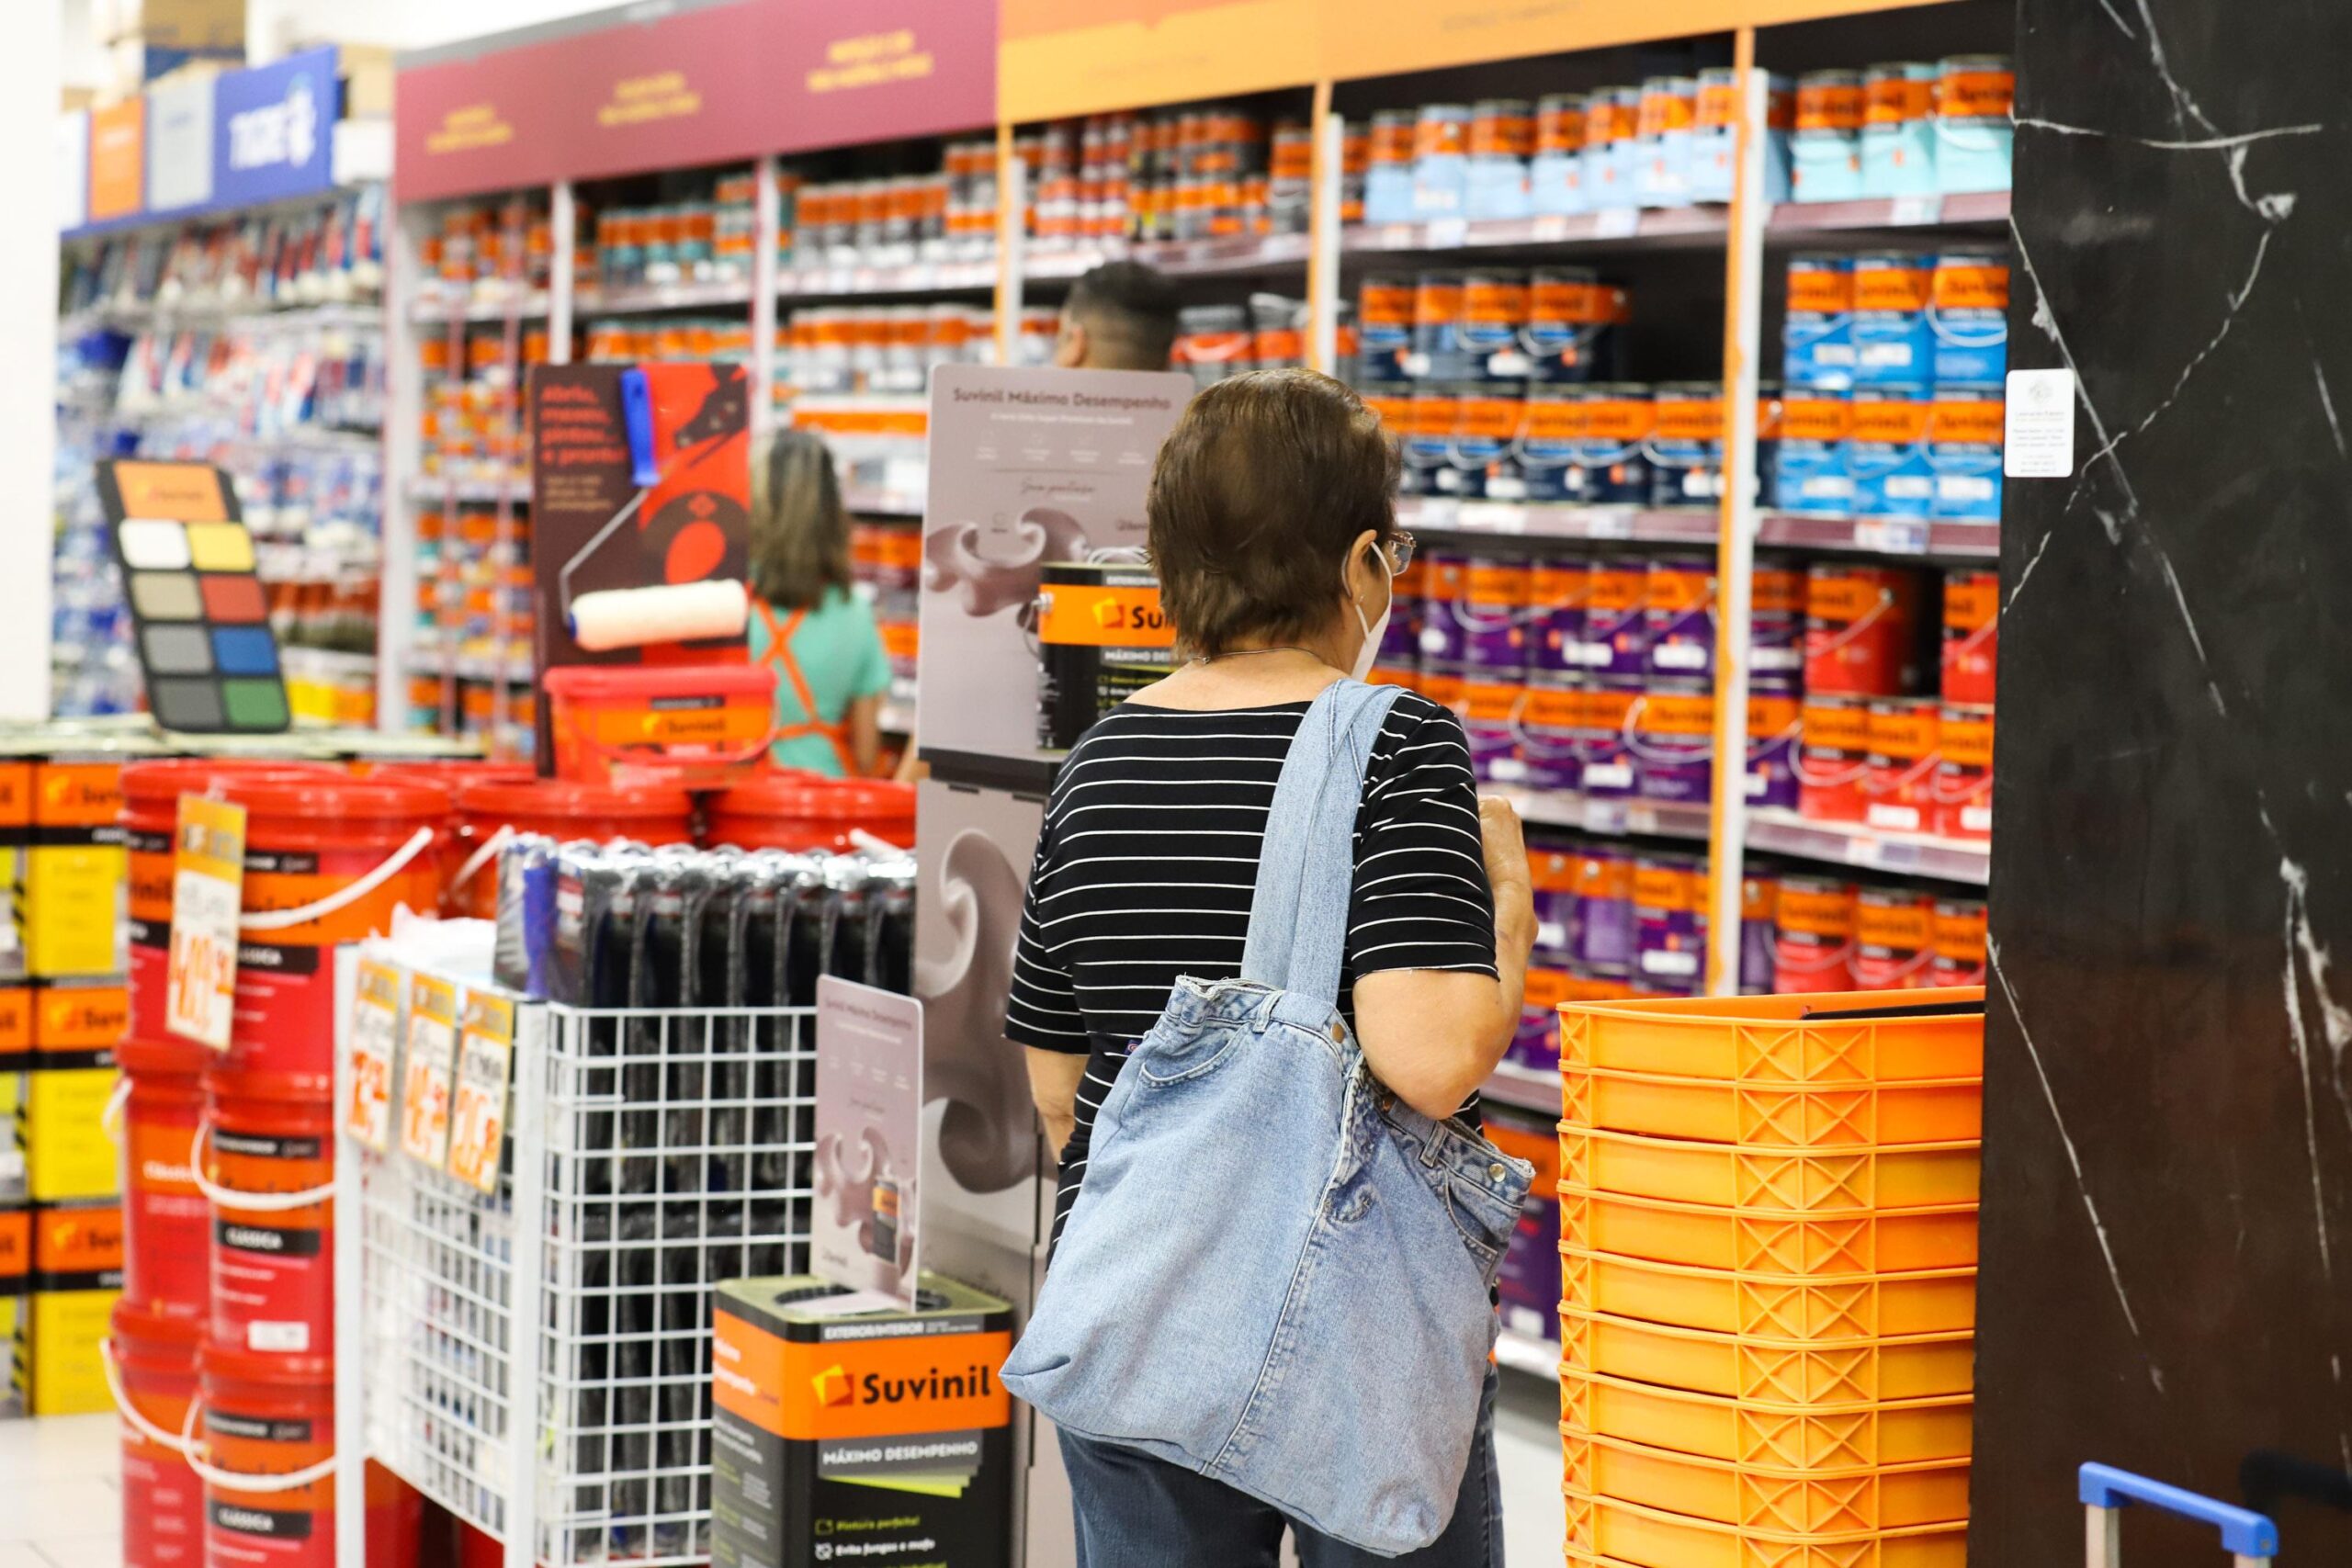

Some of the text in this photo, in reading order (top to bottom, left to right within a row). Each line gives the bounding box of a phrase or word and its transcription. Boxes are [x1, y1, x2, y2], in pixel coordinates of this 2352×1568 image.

[954, 387, 1172, 411] Suvinil Máximo Desempenho
[863, 1364, 991, 1405] Suvinil
[823, 1440, 978, 1465] MÁXIMO DESEMPENHO
[899, 1541, 907, 1551] e
